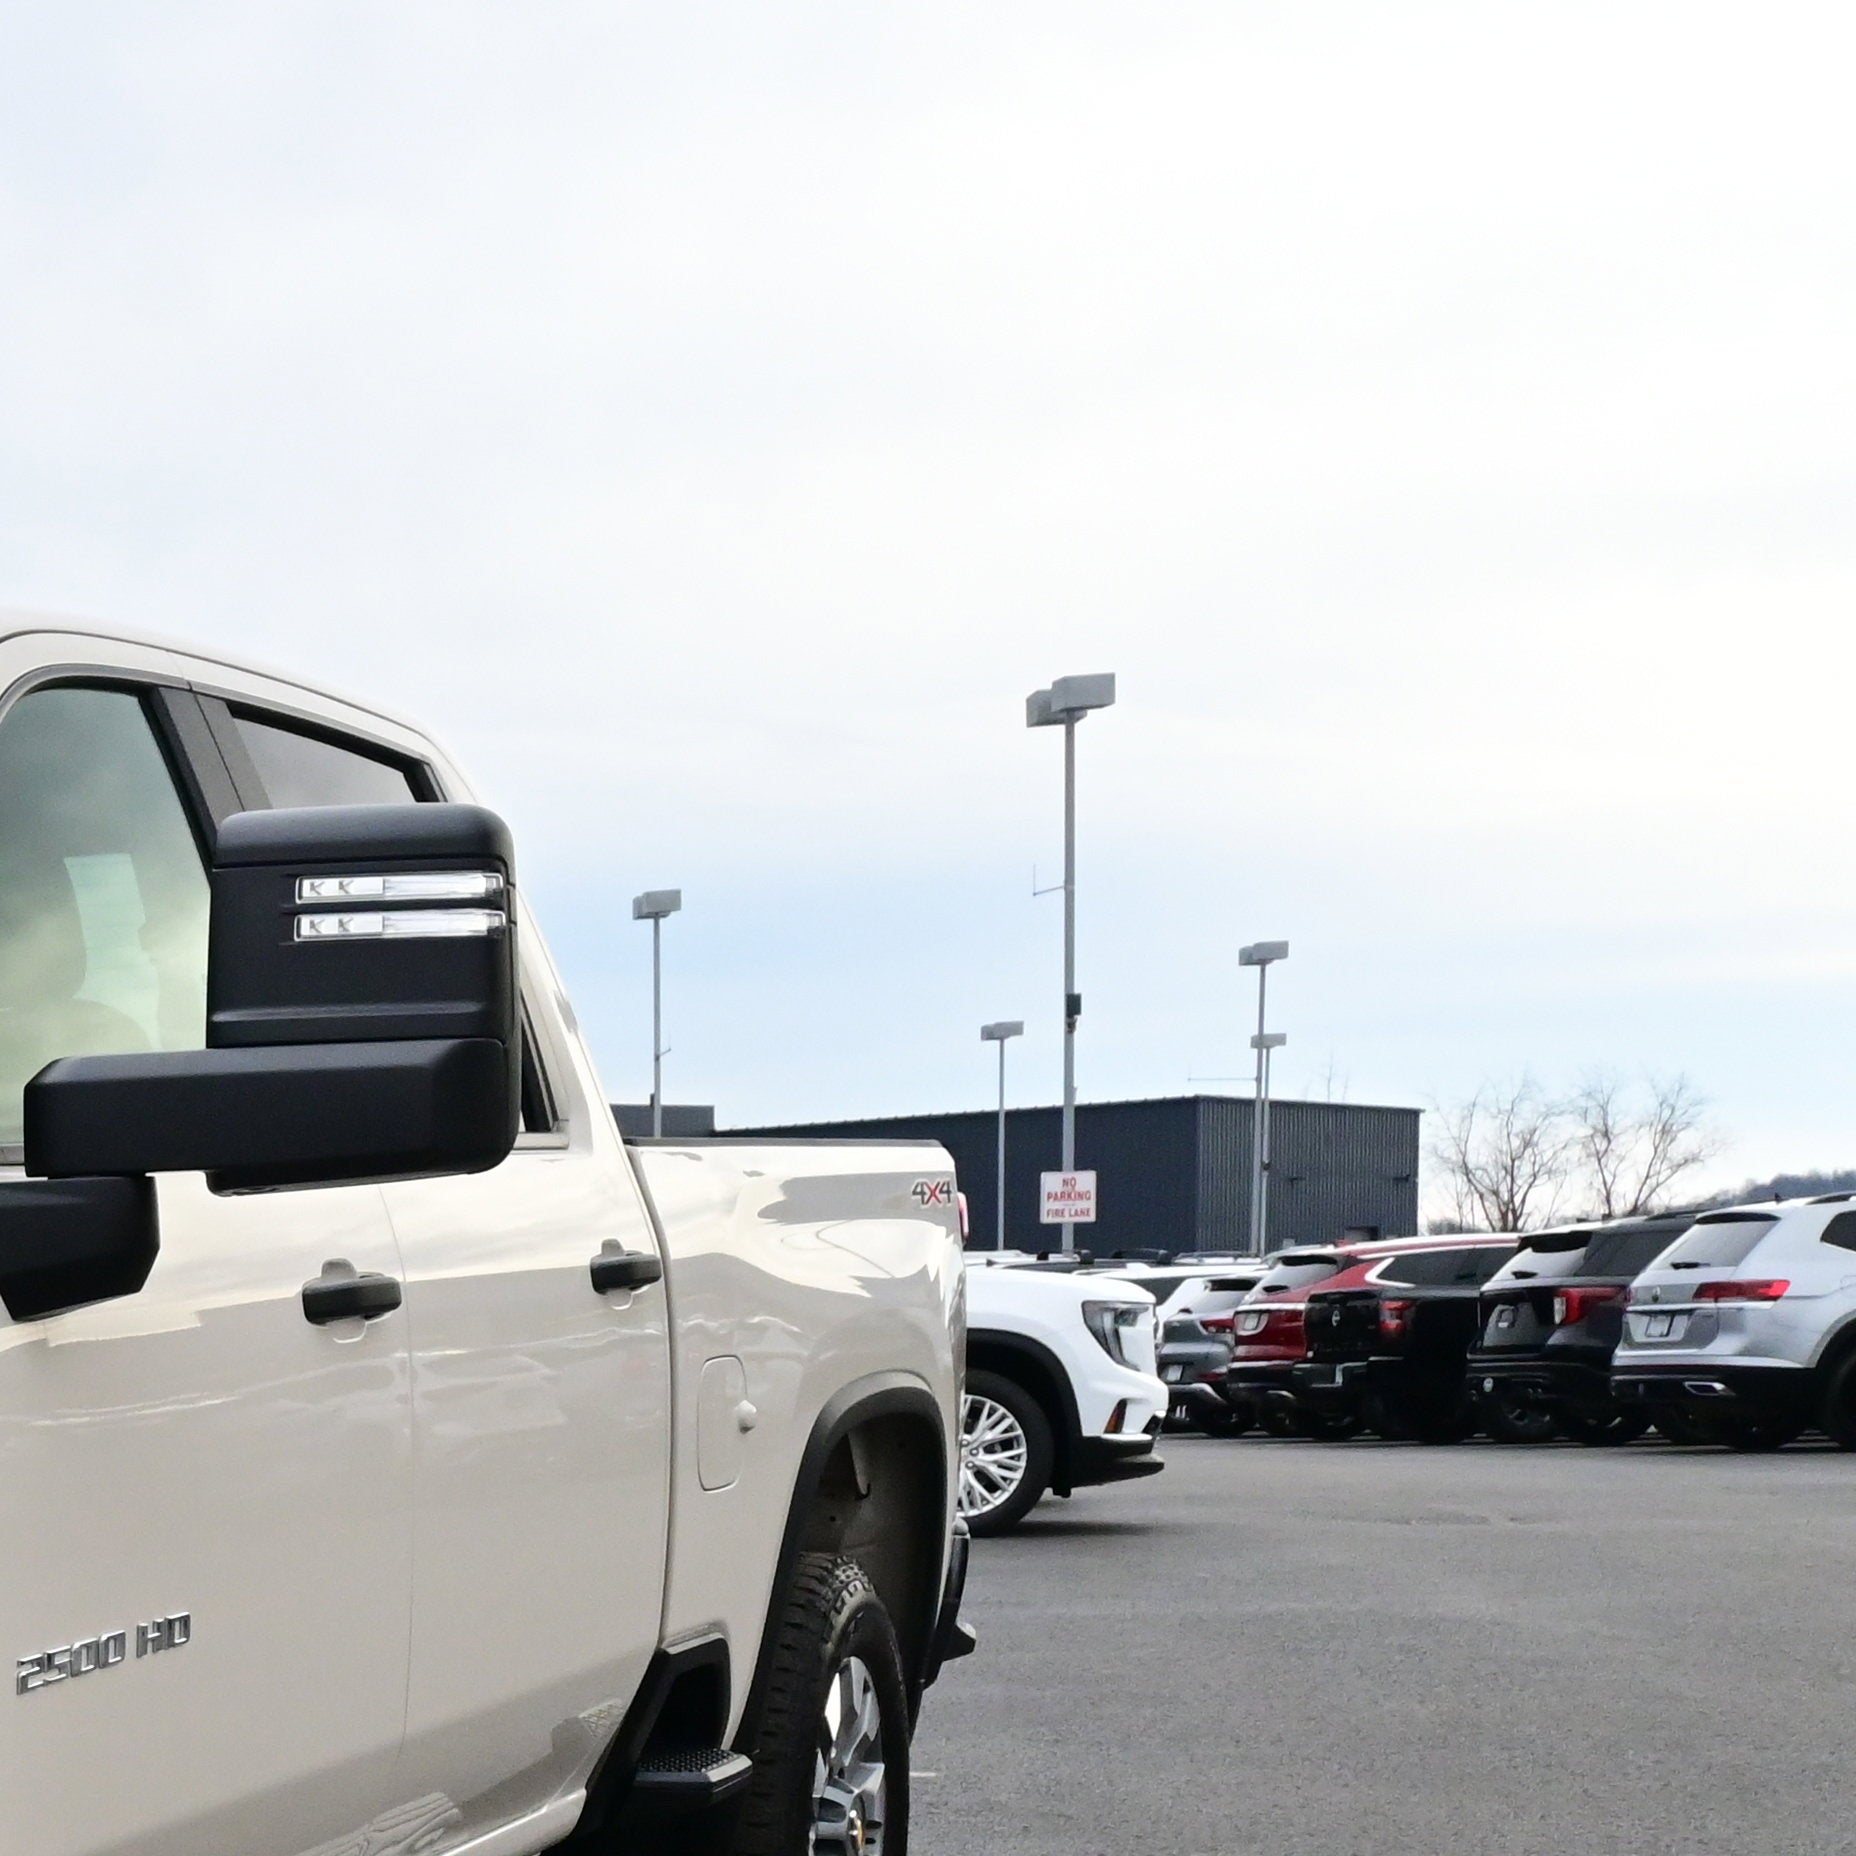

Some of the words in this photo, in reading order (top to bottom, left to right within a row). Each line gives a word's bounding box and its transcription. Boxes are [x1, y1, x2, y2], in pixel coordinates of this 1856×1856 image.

[1061, 1177, 1077, 1189] NO
[1047, 1190, 1092, 1201] PARKING
[1046, 1207, 1066, 1218] FIRE
[1068, 1206, 1091, 1217] LANE
[16, 1629, 126, 1695] 2500
[136, 1611, 191, 1659] HD
